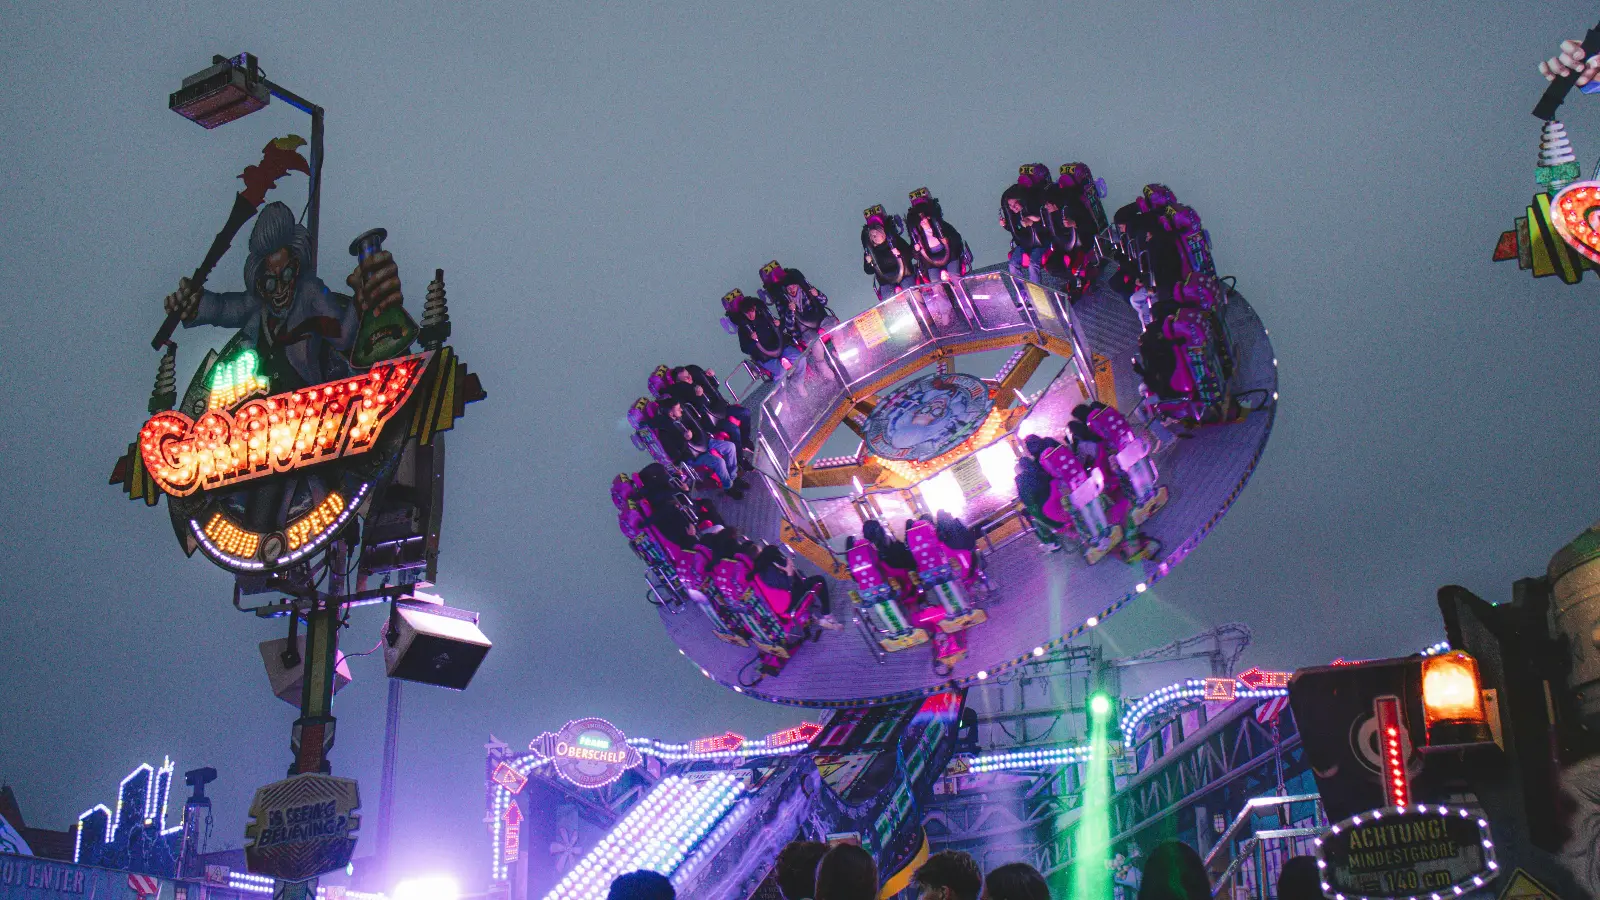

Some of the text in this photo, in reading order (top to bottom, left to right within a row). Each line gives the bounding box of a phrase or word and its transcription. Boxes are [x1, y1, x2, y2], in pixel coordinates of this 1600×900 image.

[141, 352, 435, 496] GRAVITY
[288, 490, 345, 550] SPEED
[556, 741, 626, 763] OBERSCHELP
[286, 800, 337, 824] SEEING
[258, 815, 346, 846] BELIEVING?
[1350, 819, 1448, 849] ACHTUNG!
[1, 860, 84, 893] OT ENTER
[1387, 871, 1418, 892] 140
[1423, 872, 1452, 889] cm
